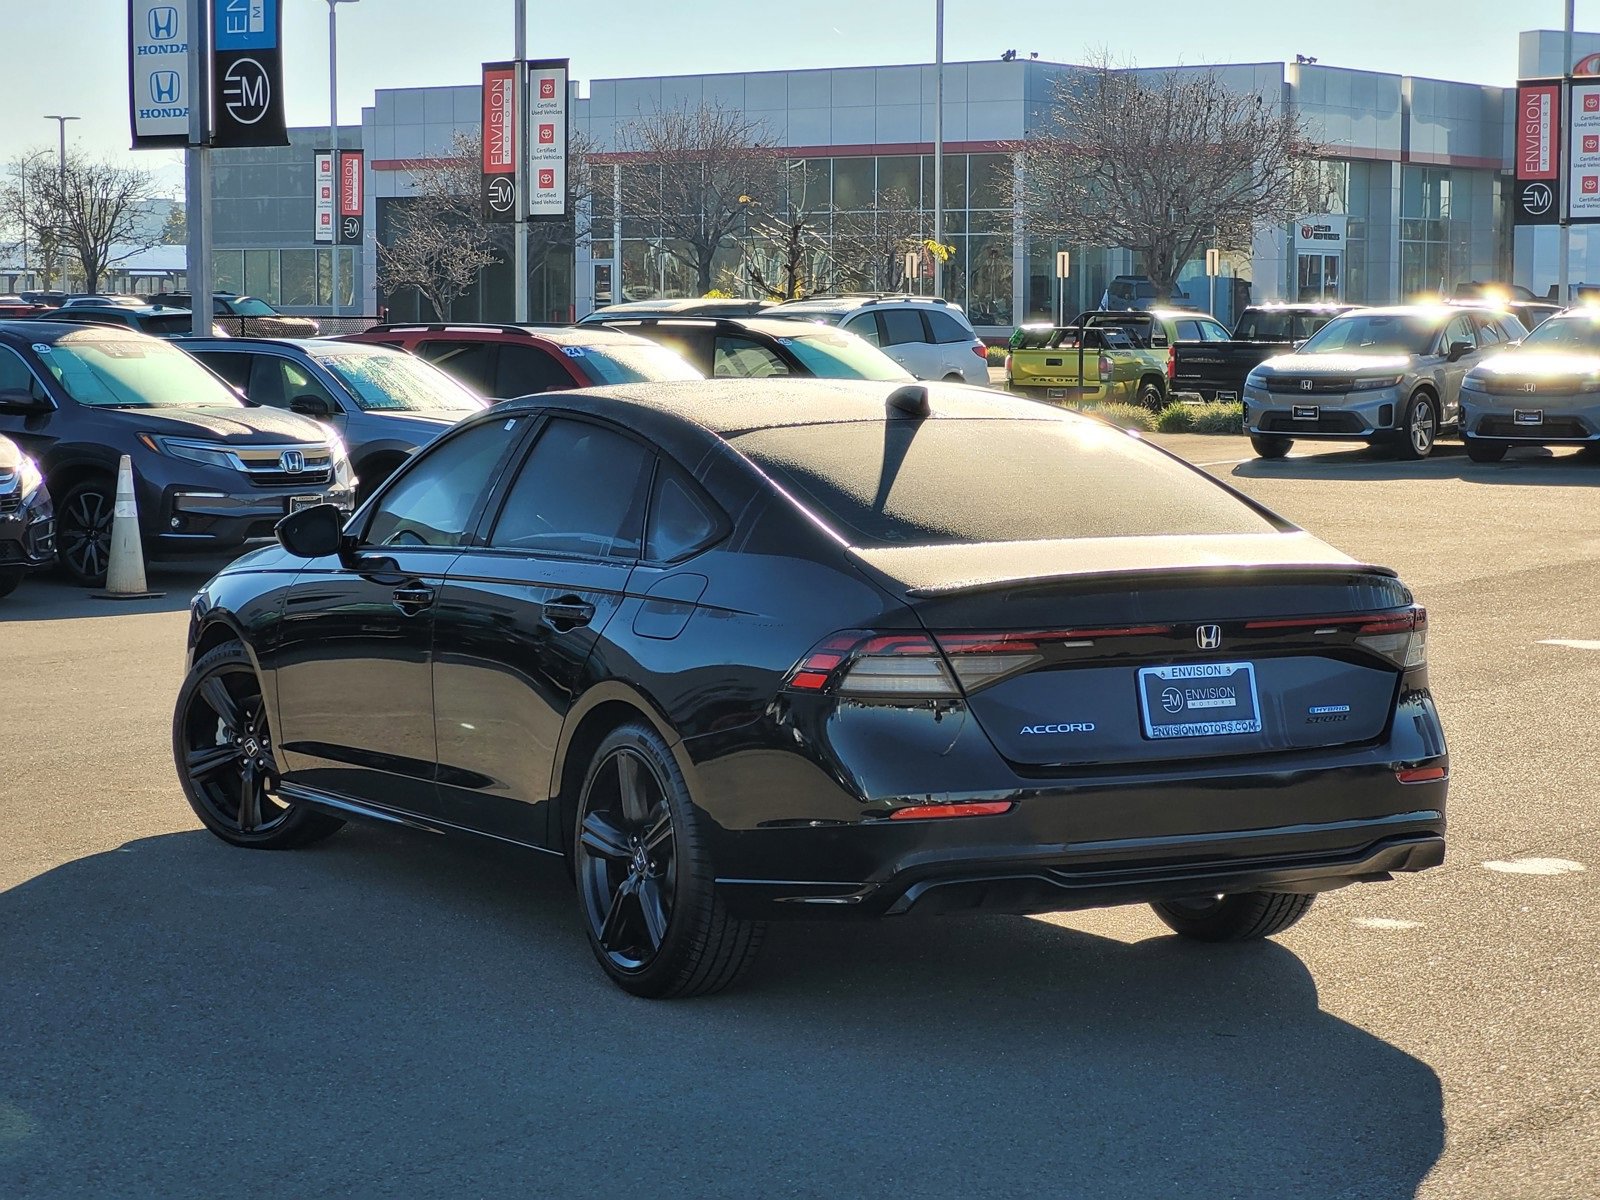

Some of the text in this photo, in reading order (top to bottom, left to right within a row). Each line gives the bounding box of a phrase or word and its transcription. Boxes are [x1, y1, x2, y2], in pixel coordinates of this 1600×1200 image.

[137, 43, 188, 56] HONDA
[139, 107, 189, 119] HONDA
[490, 79, 503, 165] ENVISION
[504, 86, 512, 157] MOTORS
[1525, 93, 1540, 173] ENVISION
[344, 158, 353, 211] ENVISION
[565, 347, 581, 355] 24
[1171, 665, 1222, 678] ENVISION
[1185, 686, 1236, 700] ENVISION
[1305, 714, 1350, 724] SPORT
[1020, 722, 1095, 735] ACCORD
[1152, 722, 1257, 737] ENVISIONMOTORS.COM
